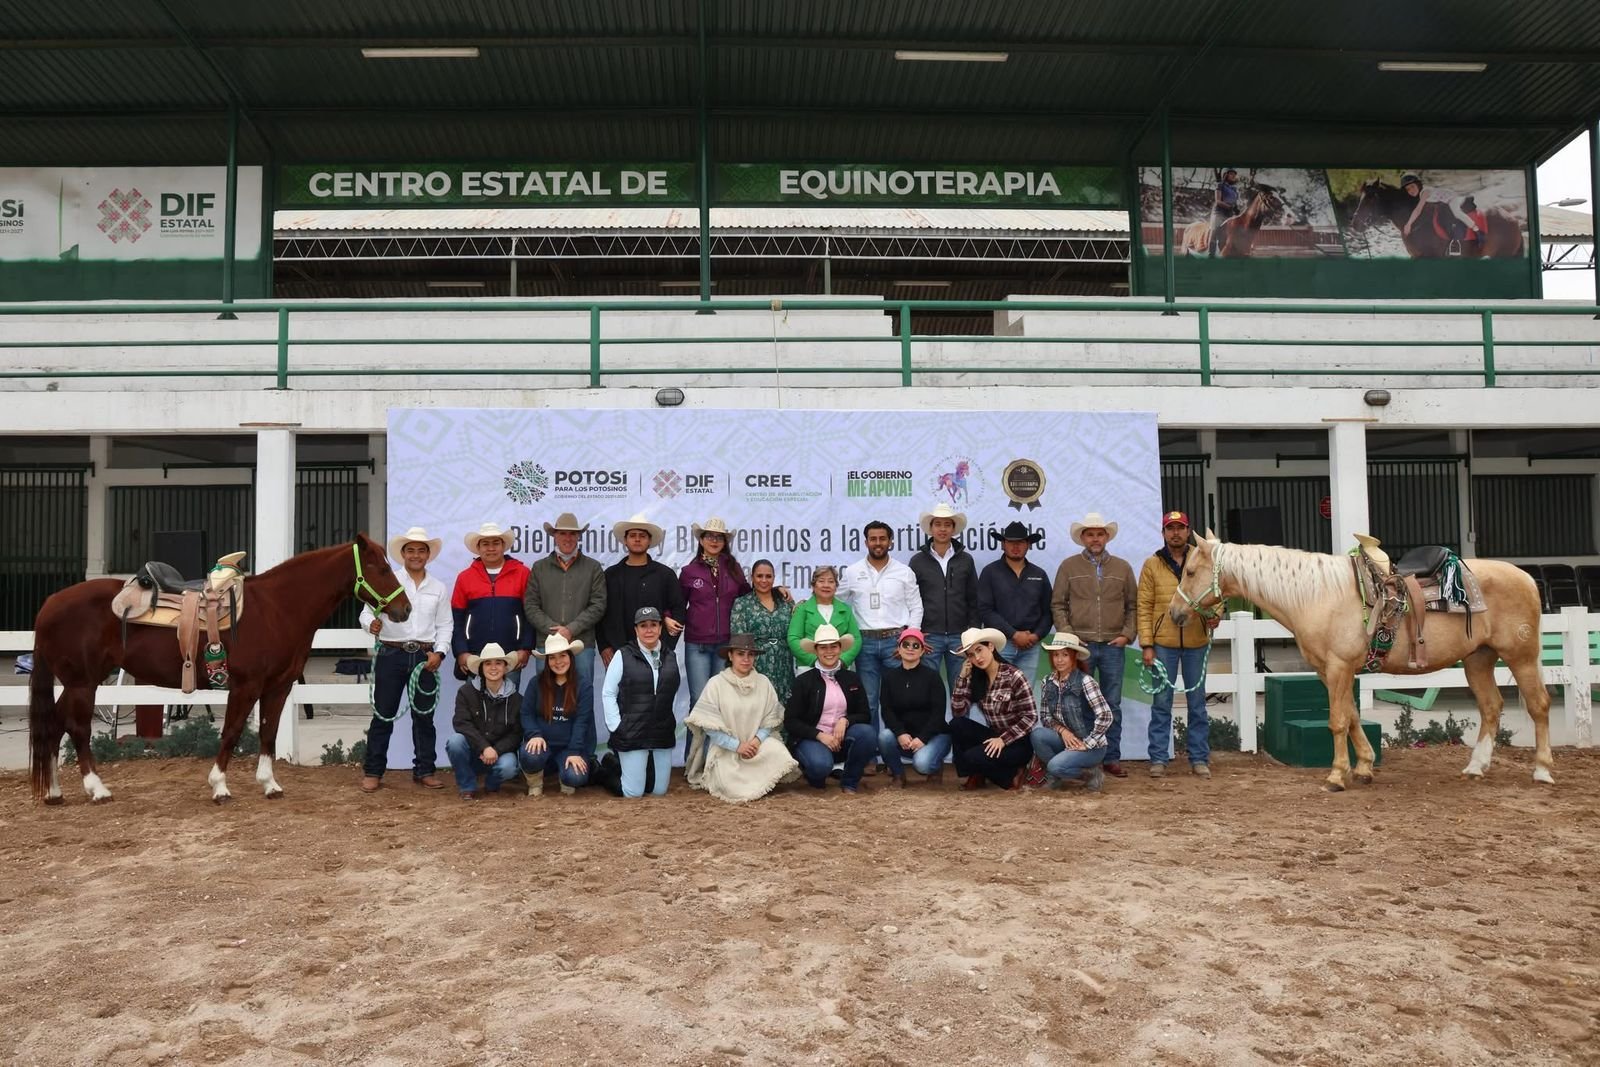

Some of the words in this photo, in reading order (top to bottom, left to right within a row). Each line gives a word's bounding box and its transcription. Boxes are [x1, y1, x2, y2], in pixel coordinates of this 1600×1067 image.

[308, 171, 452, 197] CENTRO
[461, 171, 612, 196] ESTATAL
[620, 171, 668, 195] DE
[779, 170, 1062, 199] EQUINOTERAPIA
[160, 193, 216, 216] DIF
[160, 219, 215, 228] ESTATAL
[685, 475, 714, 487] DIF
[744, 474, 792, 487] CREE
[860, 470, 913, 480] GOBIERNO
[847, 480, 867, 497] ME
[868, 480, 913, 497] APOYA!
[676, 524, 811, 553] Bienidos
[820, 528, 831, 552] a
[841, 524, 860, 552] la
